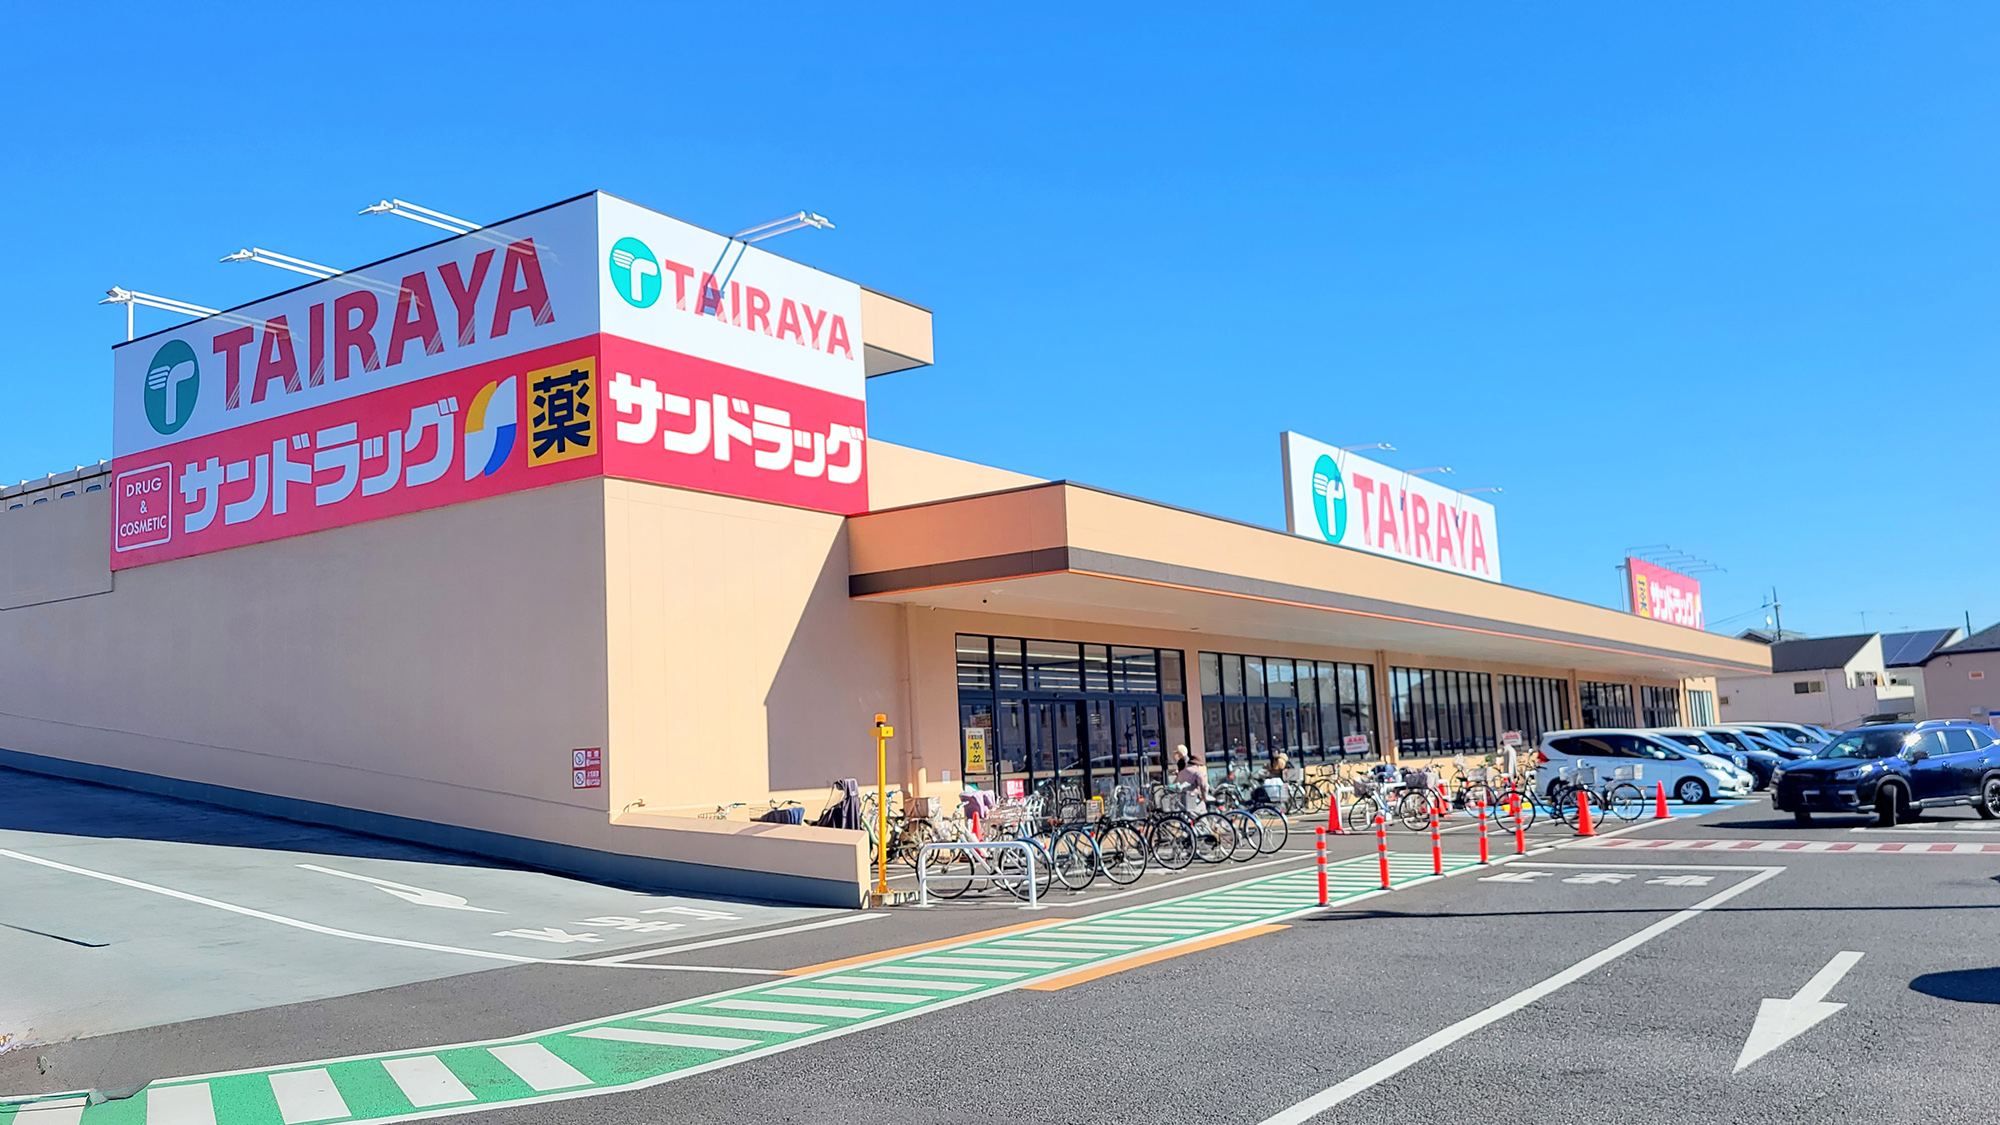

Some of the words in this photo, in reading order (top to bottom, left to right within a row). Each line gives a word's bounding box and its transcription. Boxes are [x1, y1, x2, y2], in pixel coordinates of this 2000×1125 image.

[213, 237, 554, 410] TAIRAYA
[665, 259, 854, 360] TAIRAYA
[531, 370, 591, 459] 薬
[608, 372, 863, 485] サンドラッグ
[126, 477, 162, 498] DRUG
[140, 500, 148, 514] &
[180, 396, 457, 533] サンドラッグ
[120, 515, 167, 537] COSMETIC
[1352, 473, 1489, 575] TAIRAYA
[1650, 581, 1695, 627] サンドラッグ
